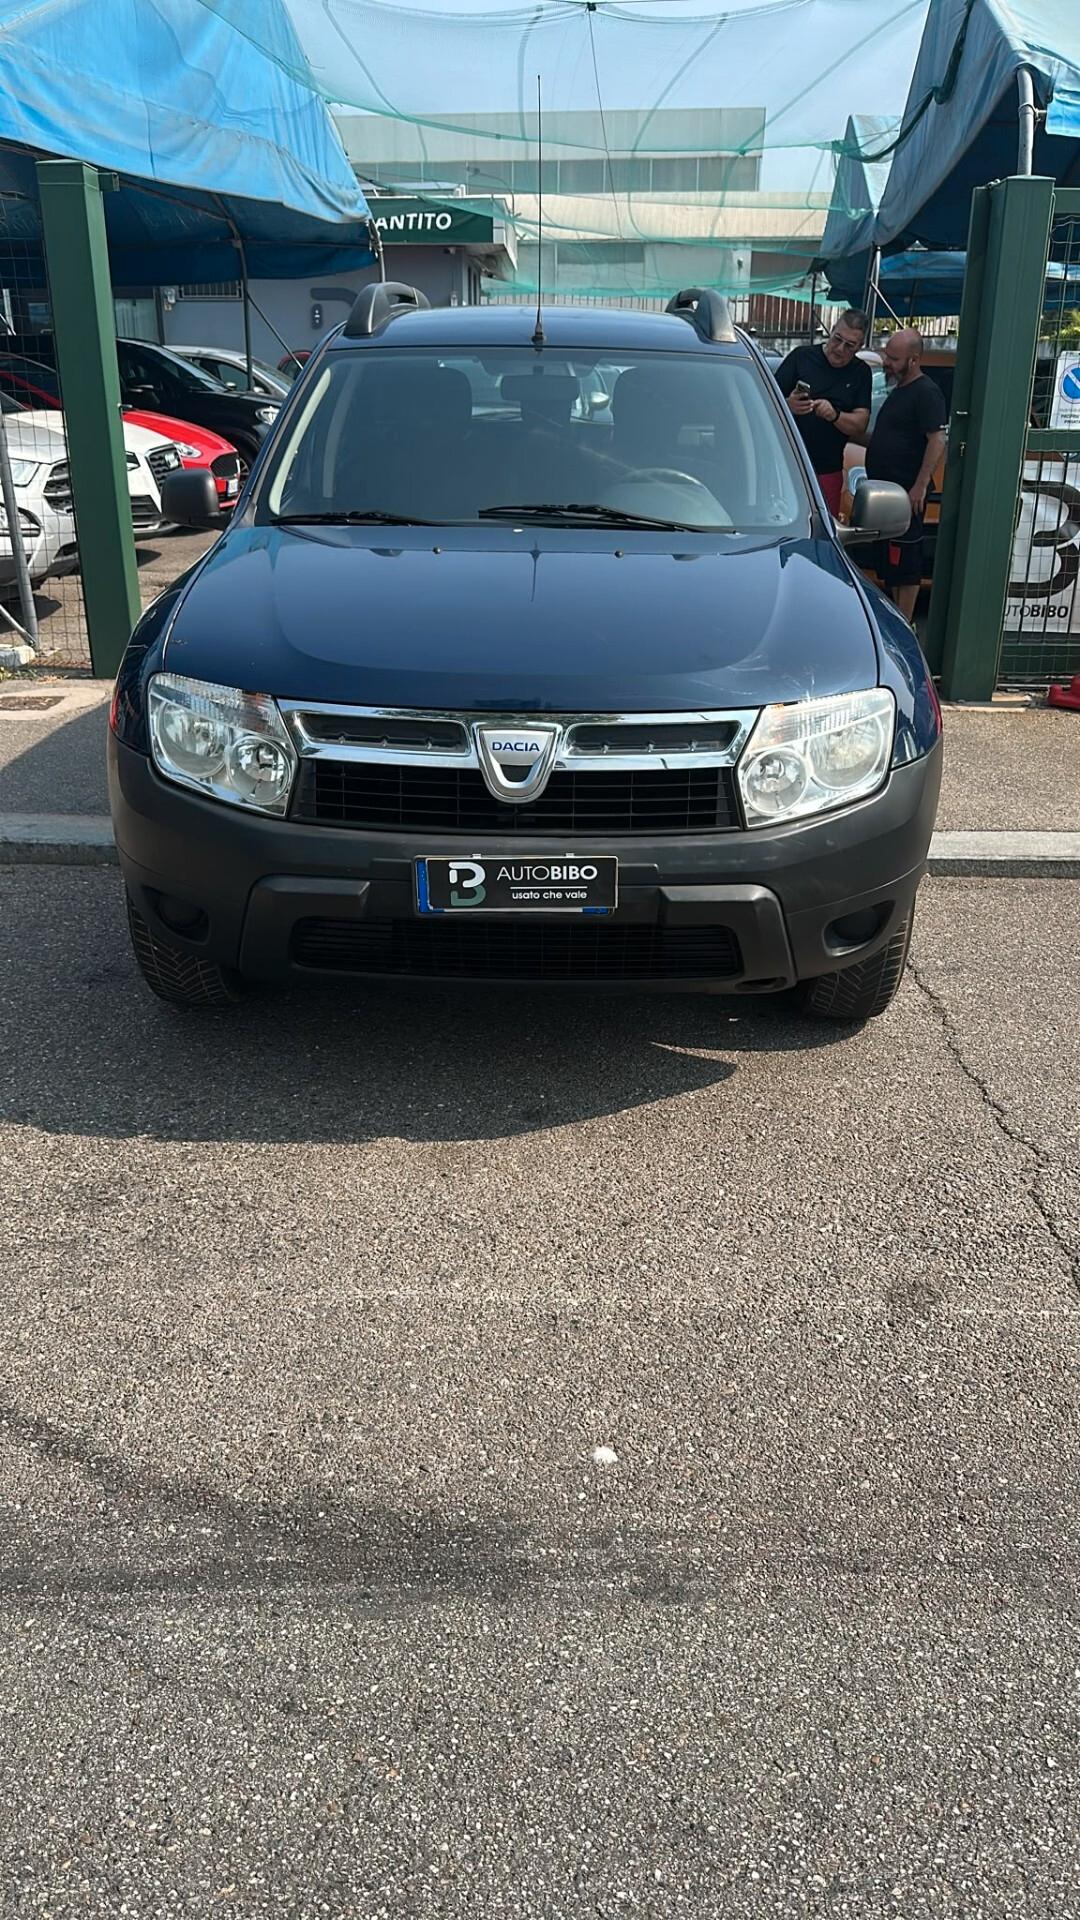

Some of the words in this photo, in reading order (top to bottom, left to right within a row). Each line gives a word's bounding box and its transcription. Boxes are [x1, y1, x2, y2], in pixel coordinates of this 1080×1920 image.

[491, 741, 540, 752] DACIA
[496, 865, 598, 880] AUTOBIBO
[512, 891, 540, 899] usato
[543, 890, 562, 899] che
[565, 890, 587, 899] vale
